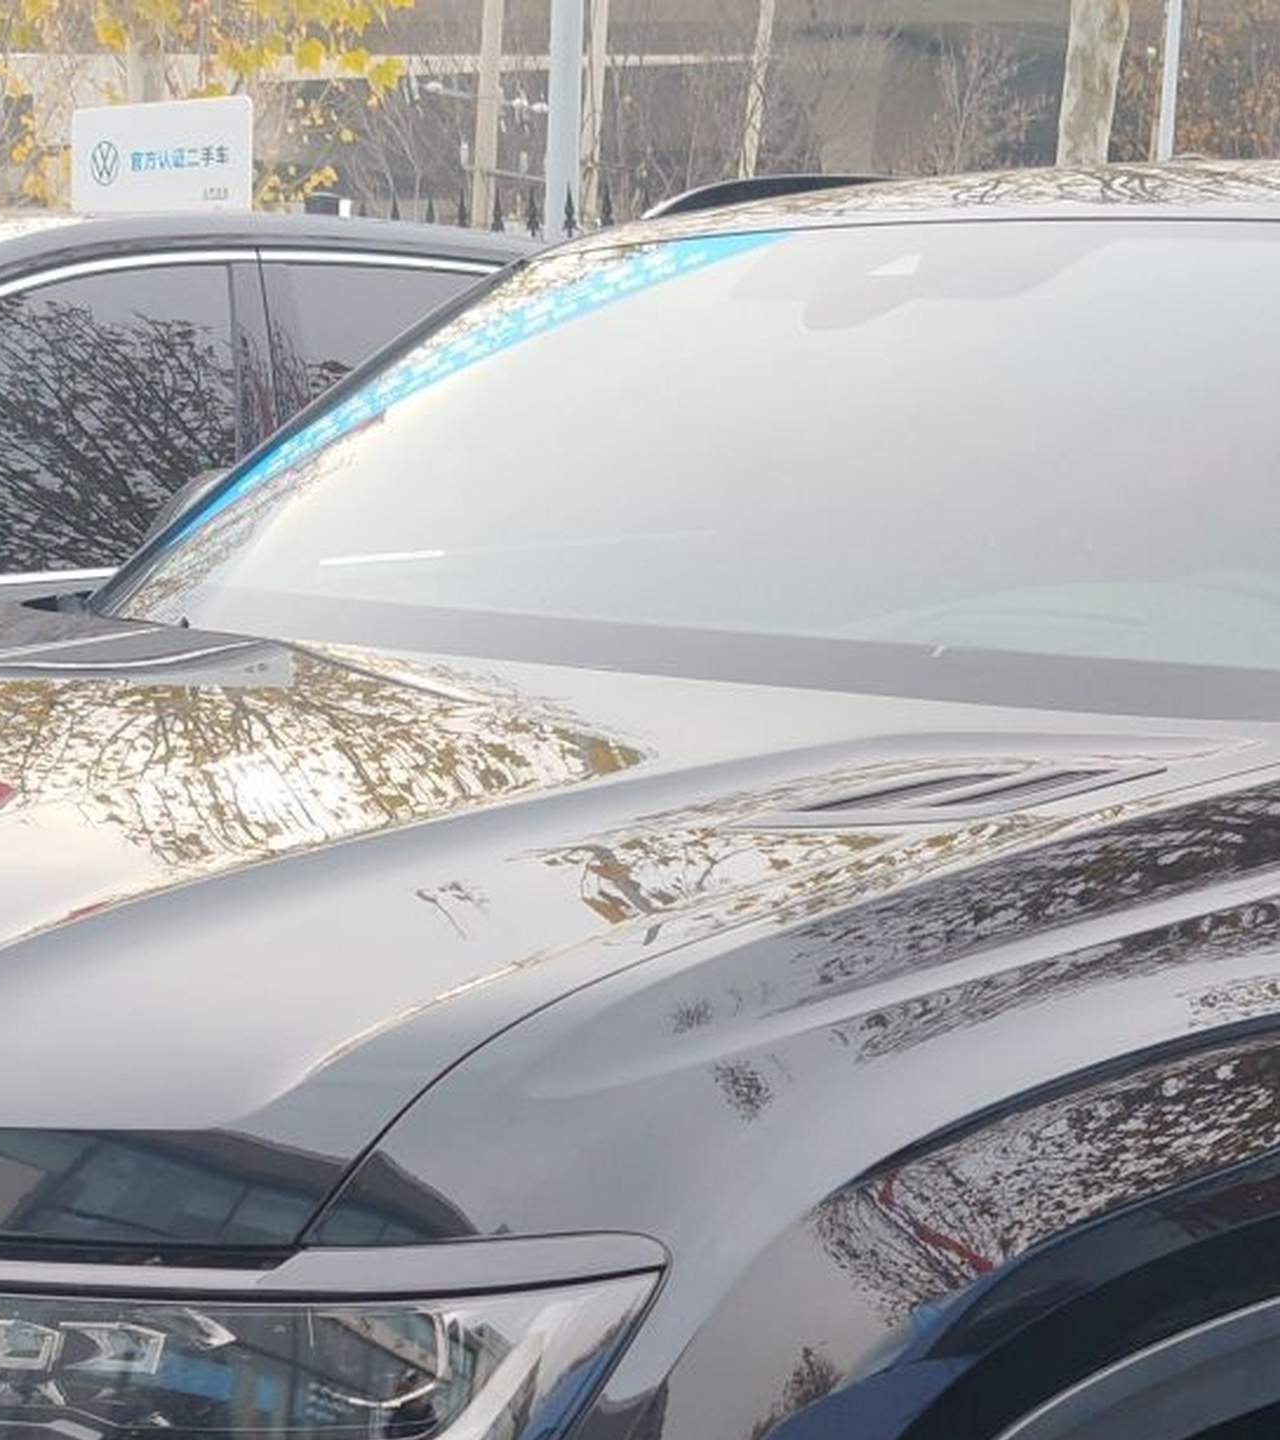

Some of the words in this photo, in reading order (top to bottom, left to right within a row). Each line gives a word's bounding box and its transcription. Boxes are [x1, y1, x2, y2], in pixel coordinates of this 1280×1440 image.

[130, 145, 230, 172] 官方认证二手车
